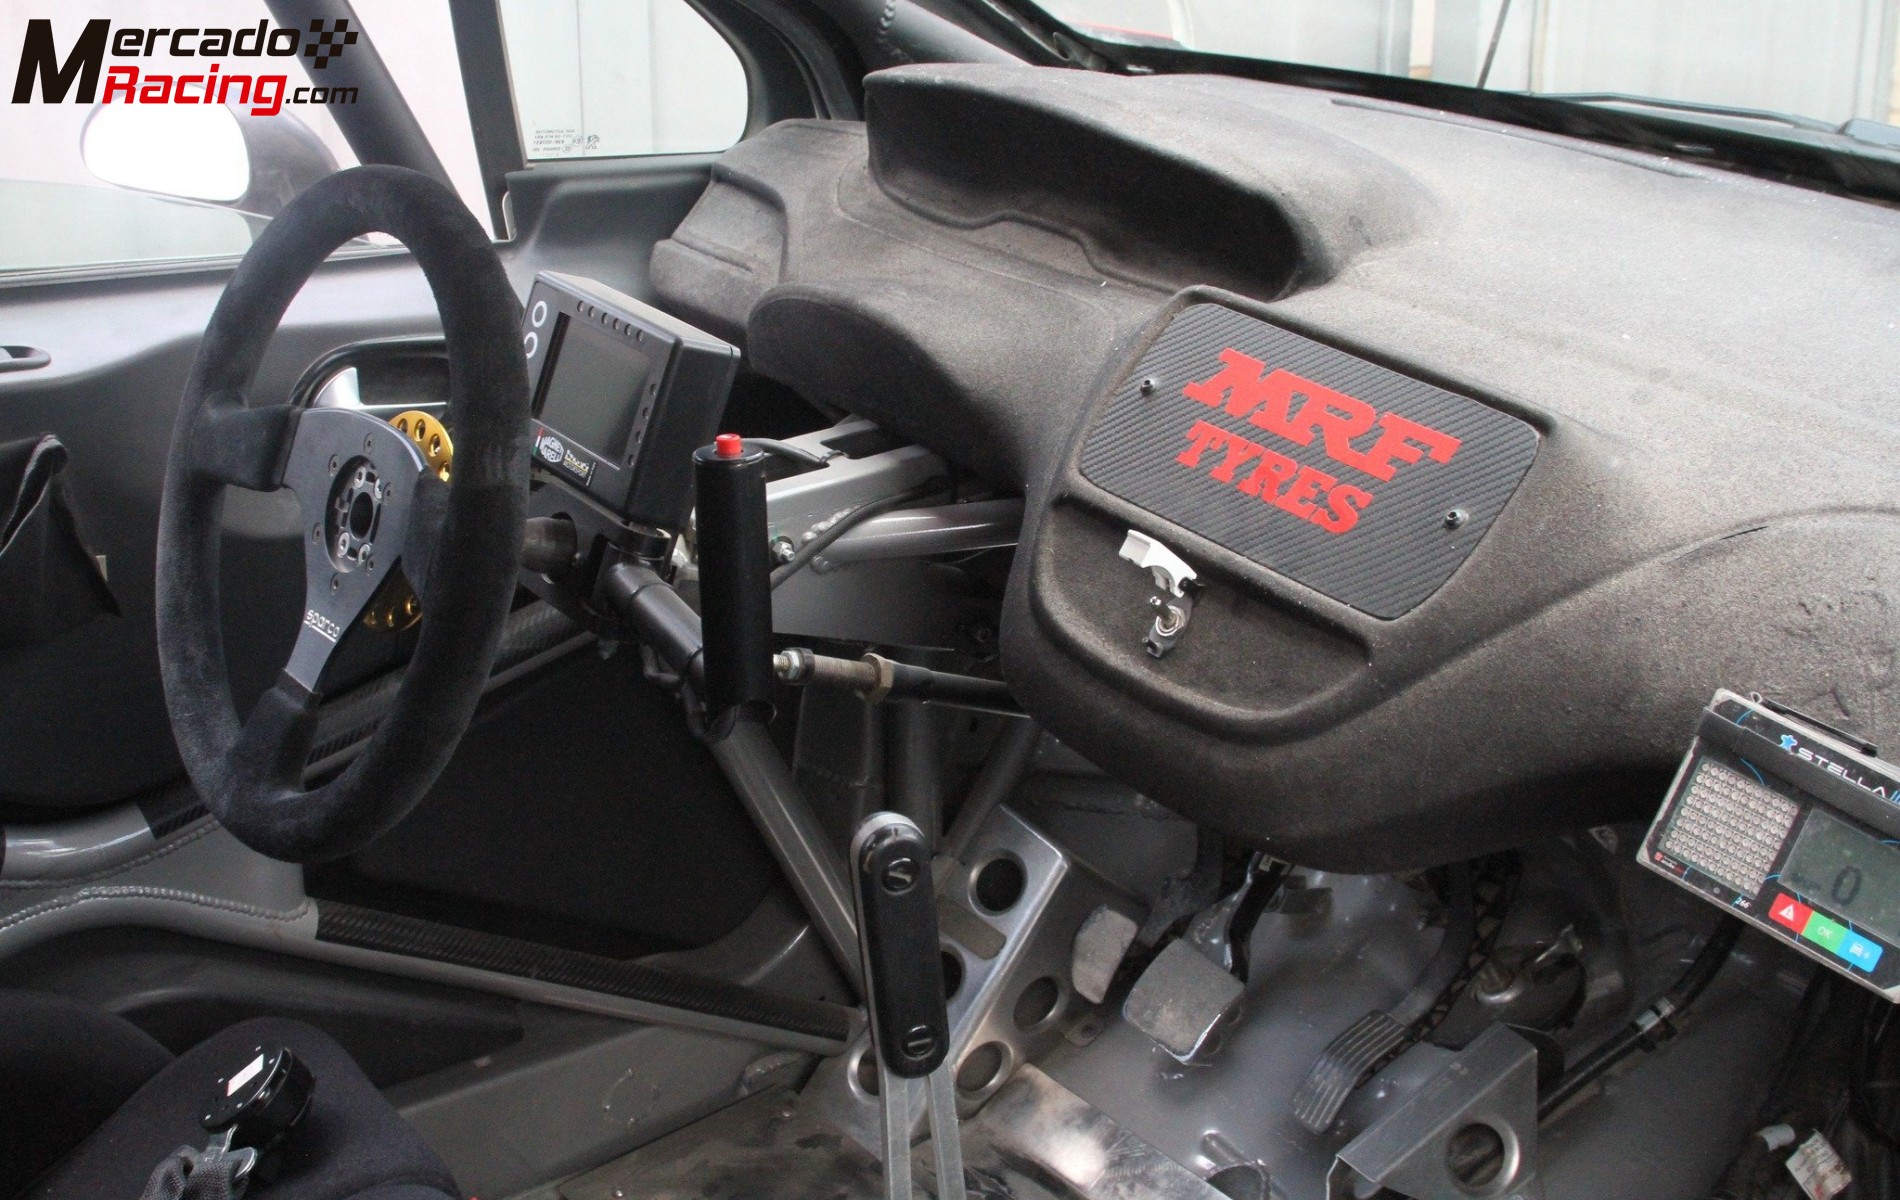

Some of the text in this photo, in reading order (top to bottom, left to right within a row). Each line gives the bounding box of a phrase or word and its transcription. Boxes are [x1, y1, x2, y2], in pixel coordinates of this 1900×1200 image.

[1182, 347, 1462, 482] MRF
[1174, 419, 1374, 534] TYRES
[306, 609, 341, 638] sparco
[1797, 747, 1886, 798] STELLA
[1817, 926, 1833, 940] OK
